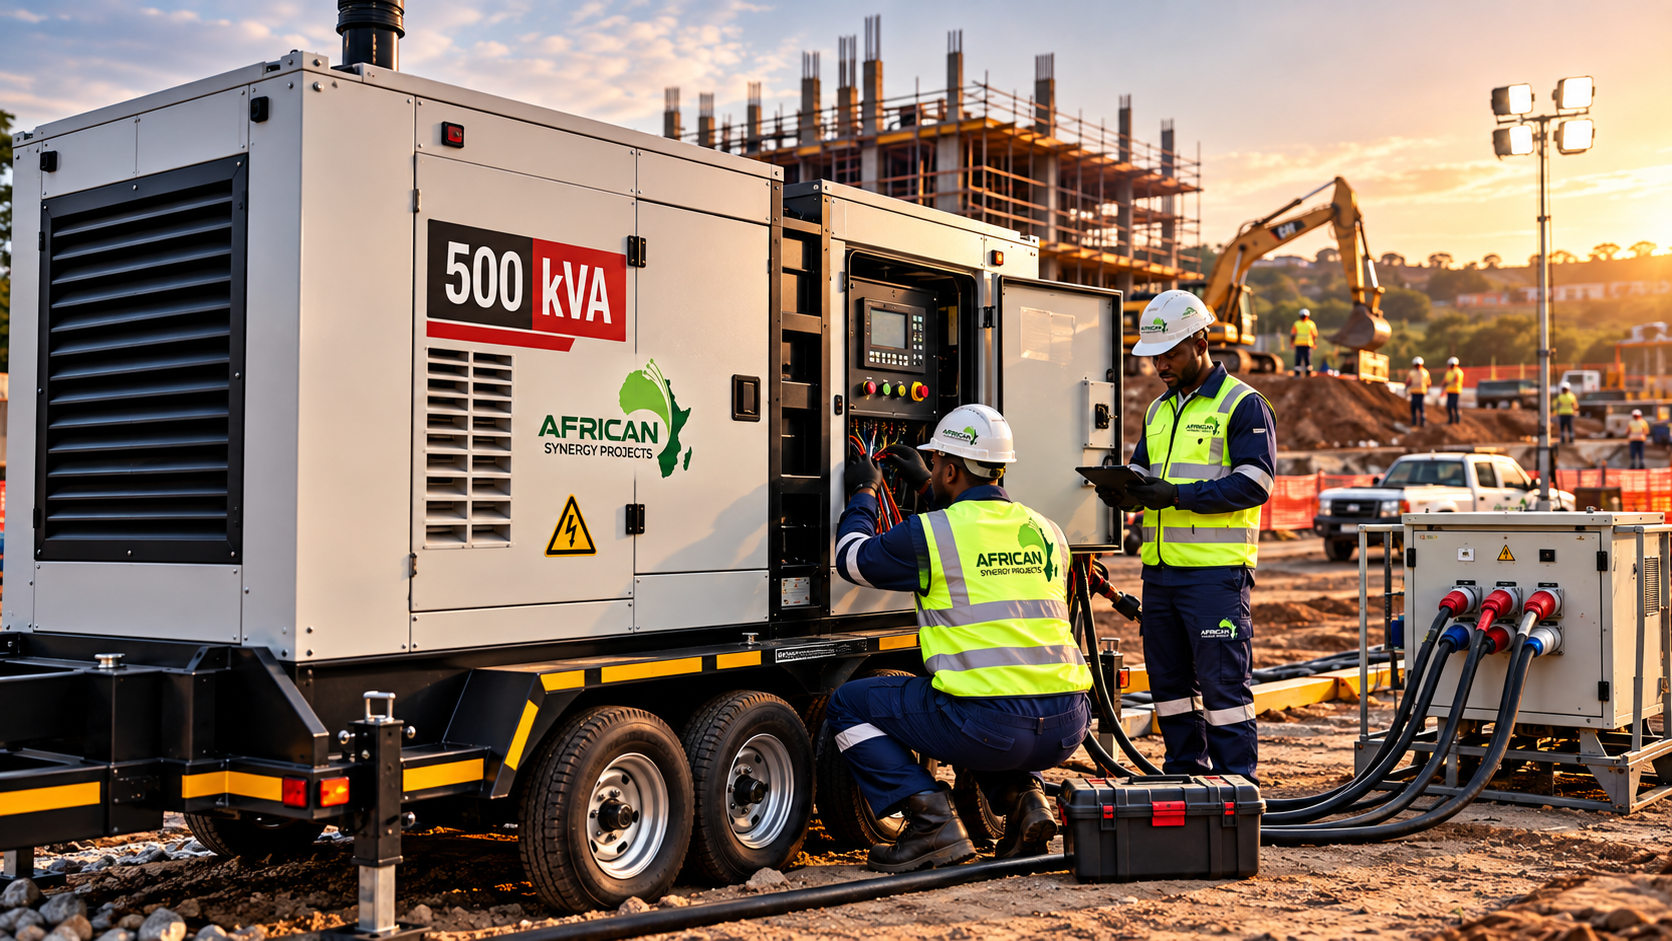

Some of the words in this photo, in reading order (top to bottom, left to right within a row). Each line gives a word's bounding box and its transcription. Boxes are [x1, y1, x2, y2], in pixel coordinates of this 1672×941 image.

[445, 241, 523, 312] 500
[542, 257, 612, 324] kVA
[538, 414, 659, 444] AFRICAN
[544, 442, 598, 456] SYNERGY
[600, 445, 653, 459] PROJECTS
[976, 551, 1043, 567] AFRICAN
